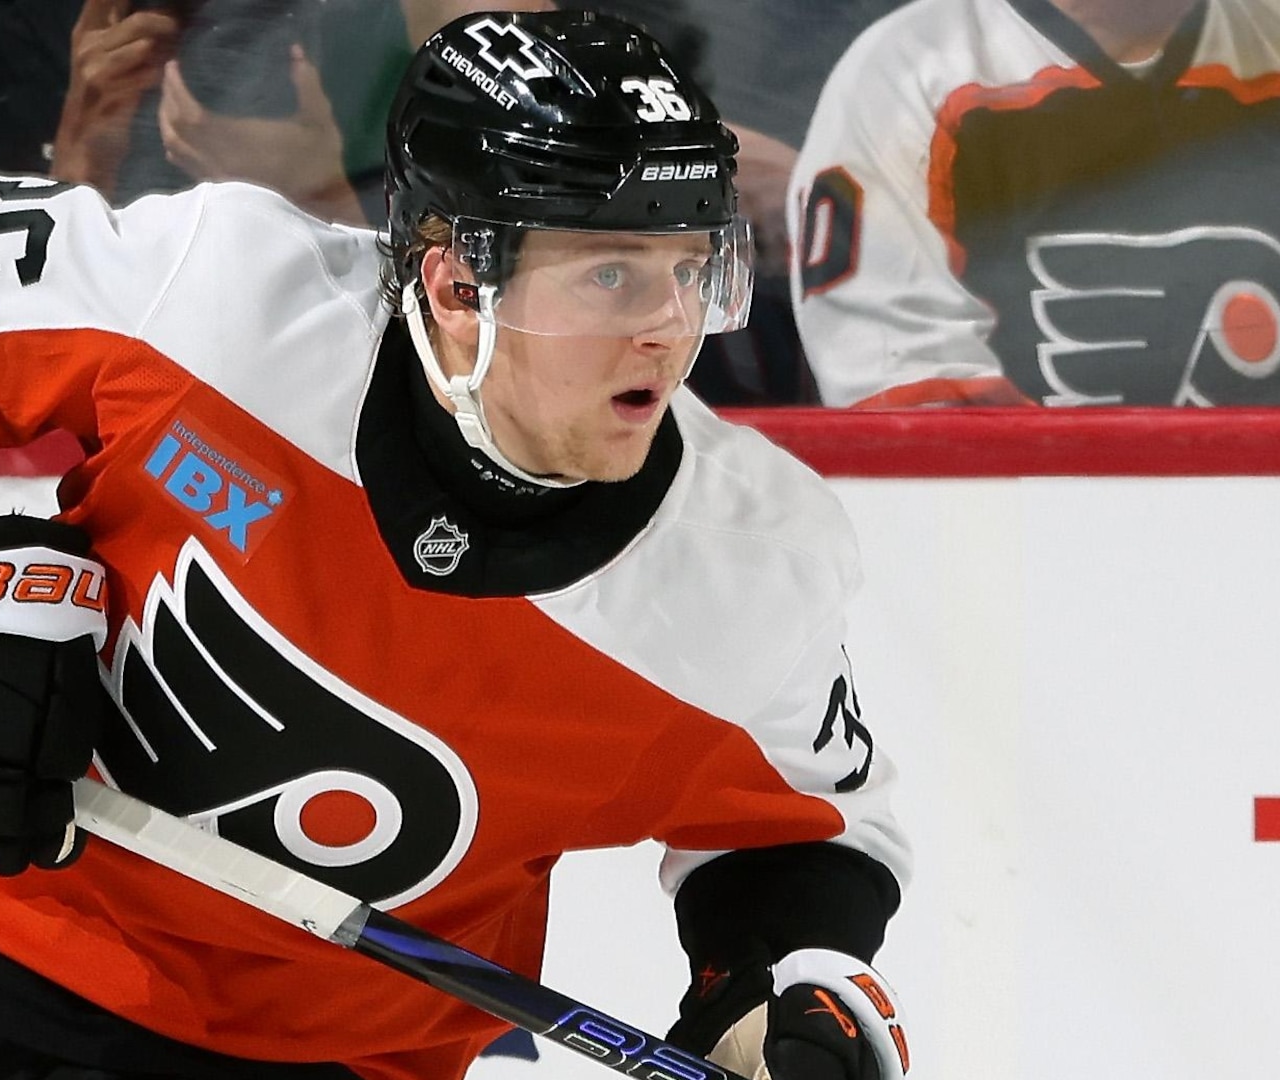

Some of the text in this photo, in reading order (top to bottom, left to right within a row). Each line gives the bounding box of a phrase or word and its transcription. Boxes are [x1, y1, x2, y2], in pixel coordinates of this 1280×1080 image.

[441, 45, 519, 112] CHEVROLET
[621, 76, 692, 123] 36
[786, 164, 866, 304] 0
[171, 420, 266, 494] Independence
[144, 433, 274, 553] IBX
[423, 542, 458, 554] NHL
